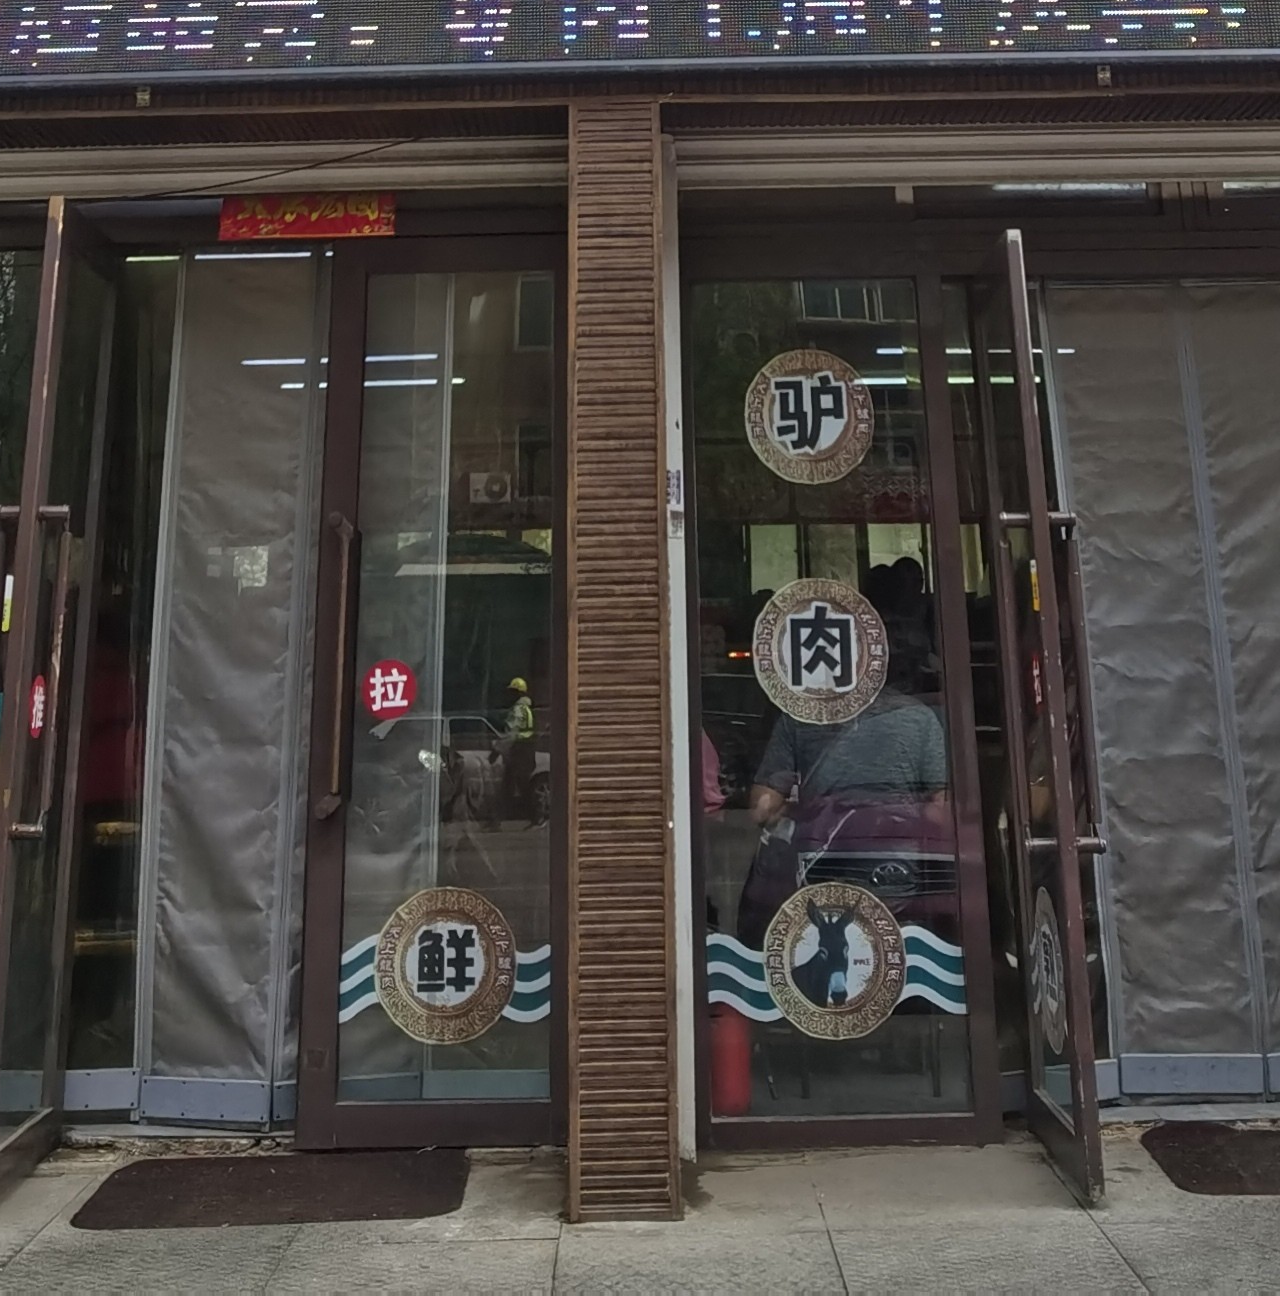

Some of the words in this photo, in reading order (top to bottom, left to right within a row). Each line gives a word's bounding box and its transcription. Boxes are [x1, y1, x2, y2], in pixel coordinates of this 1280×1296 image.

[774, 375, 845, 450] 驴
[789, 605, 852, 688] 肉
[369, 668, 409, 711] 拉
[416, 929, 476, 993] 鲜
